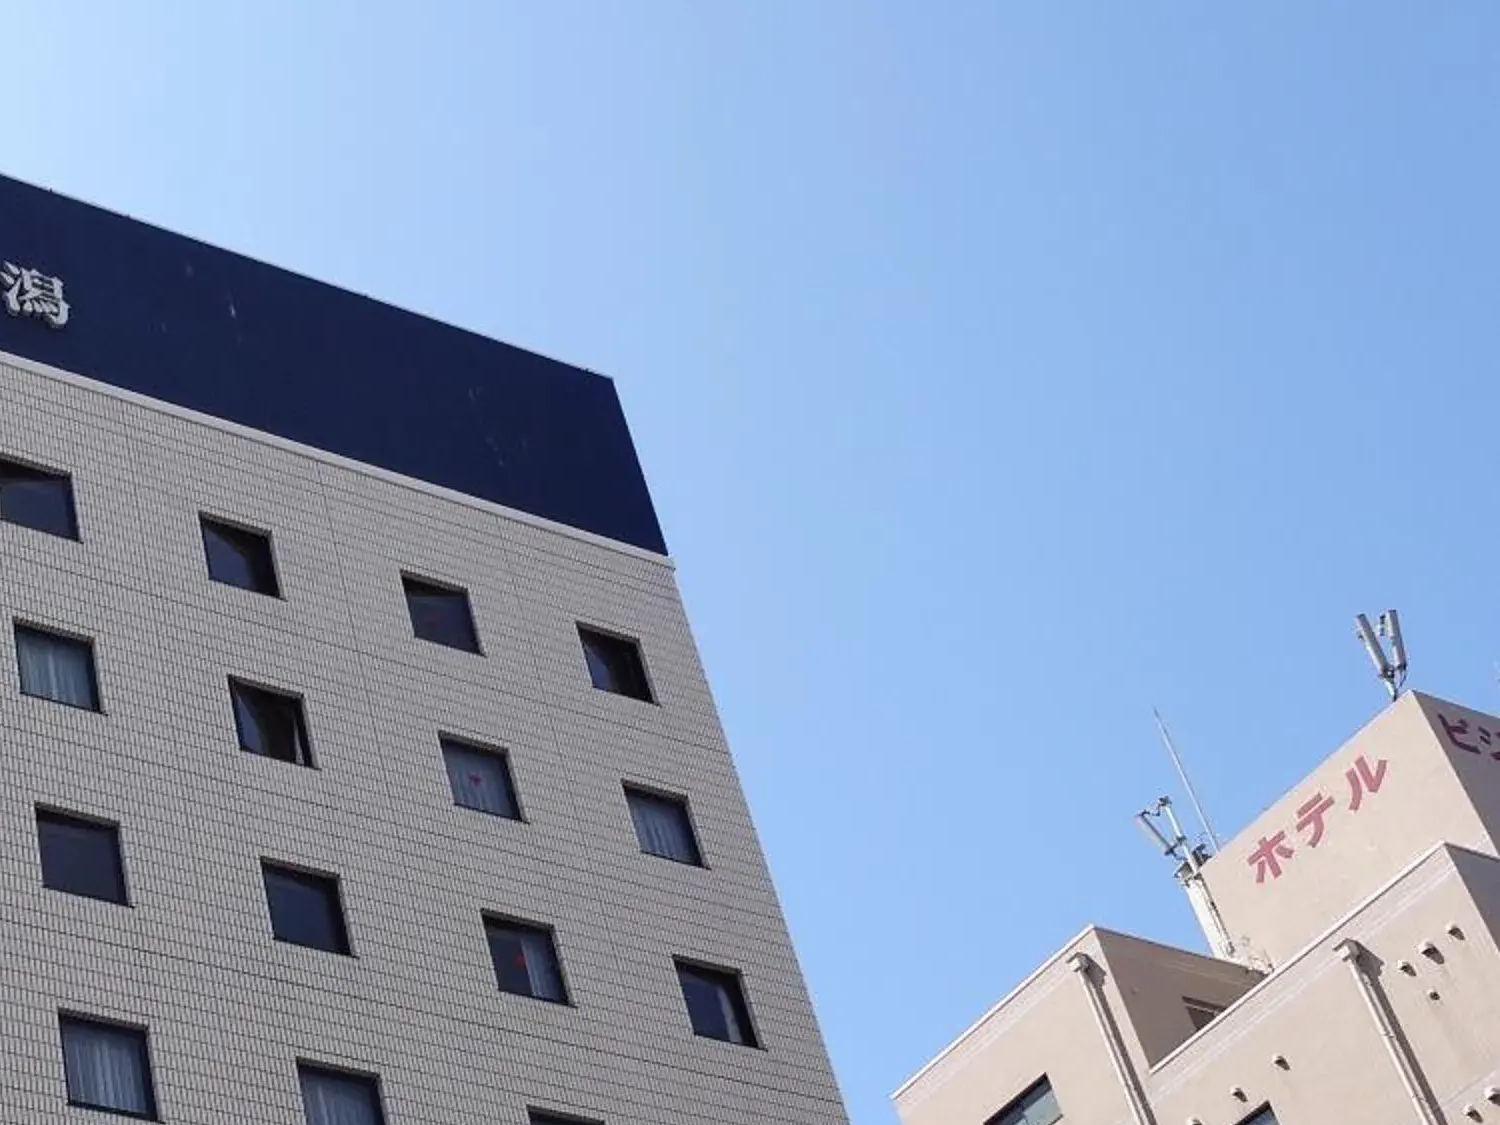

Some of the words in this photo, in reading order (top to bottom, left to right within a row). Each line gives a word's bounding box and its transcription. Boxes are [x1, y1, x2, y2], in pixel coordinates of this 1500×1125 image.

[1437, 713, 1500, 761] ビ
[1247, 755, 1388, 884] ホテル
